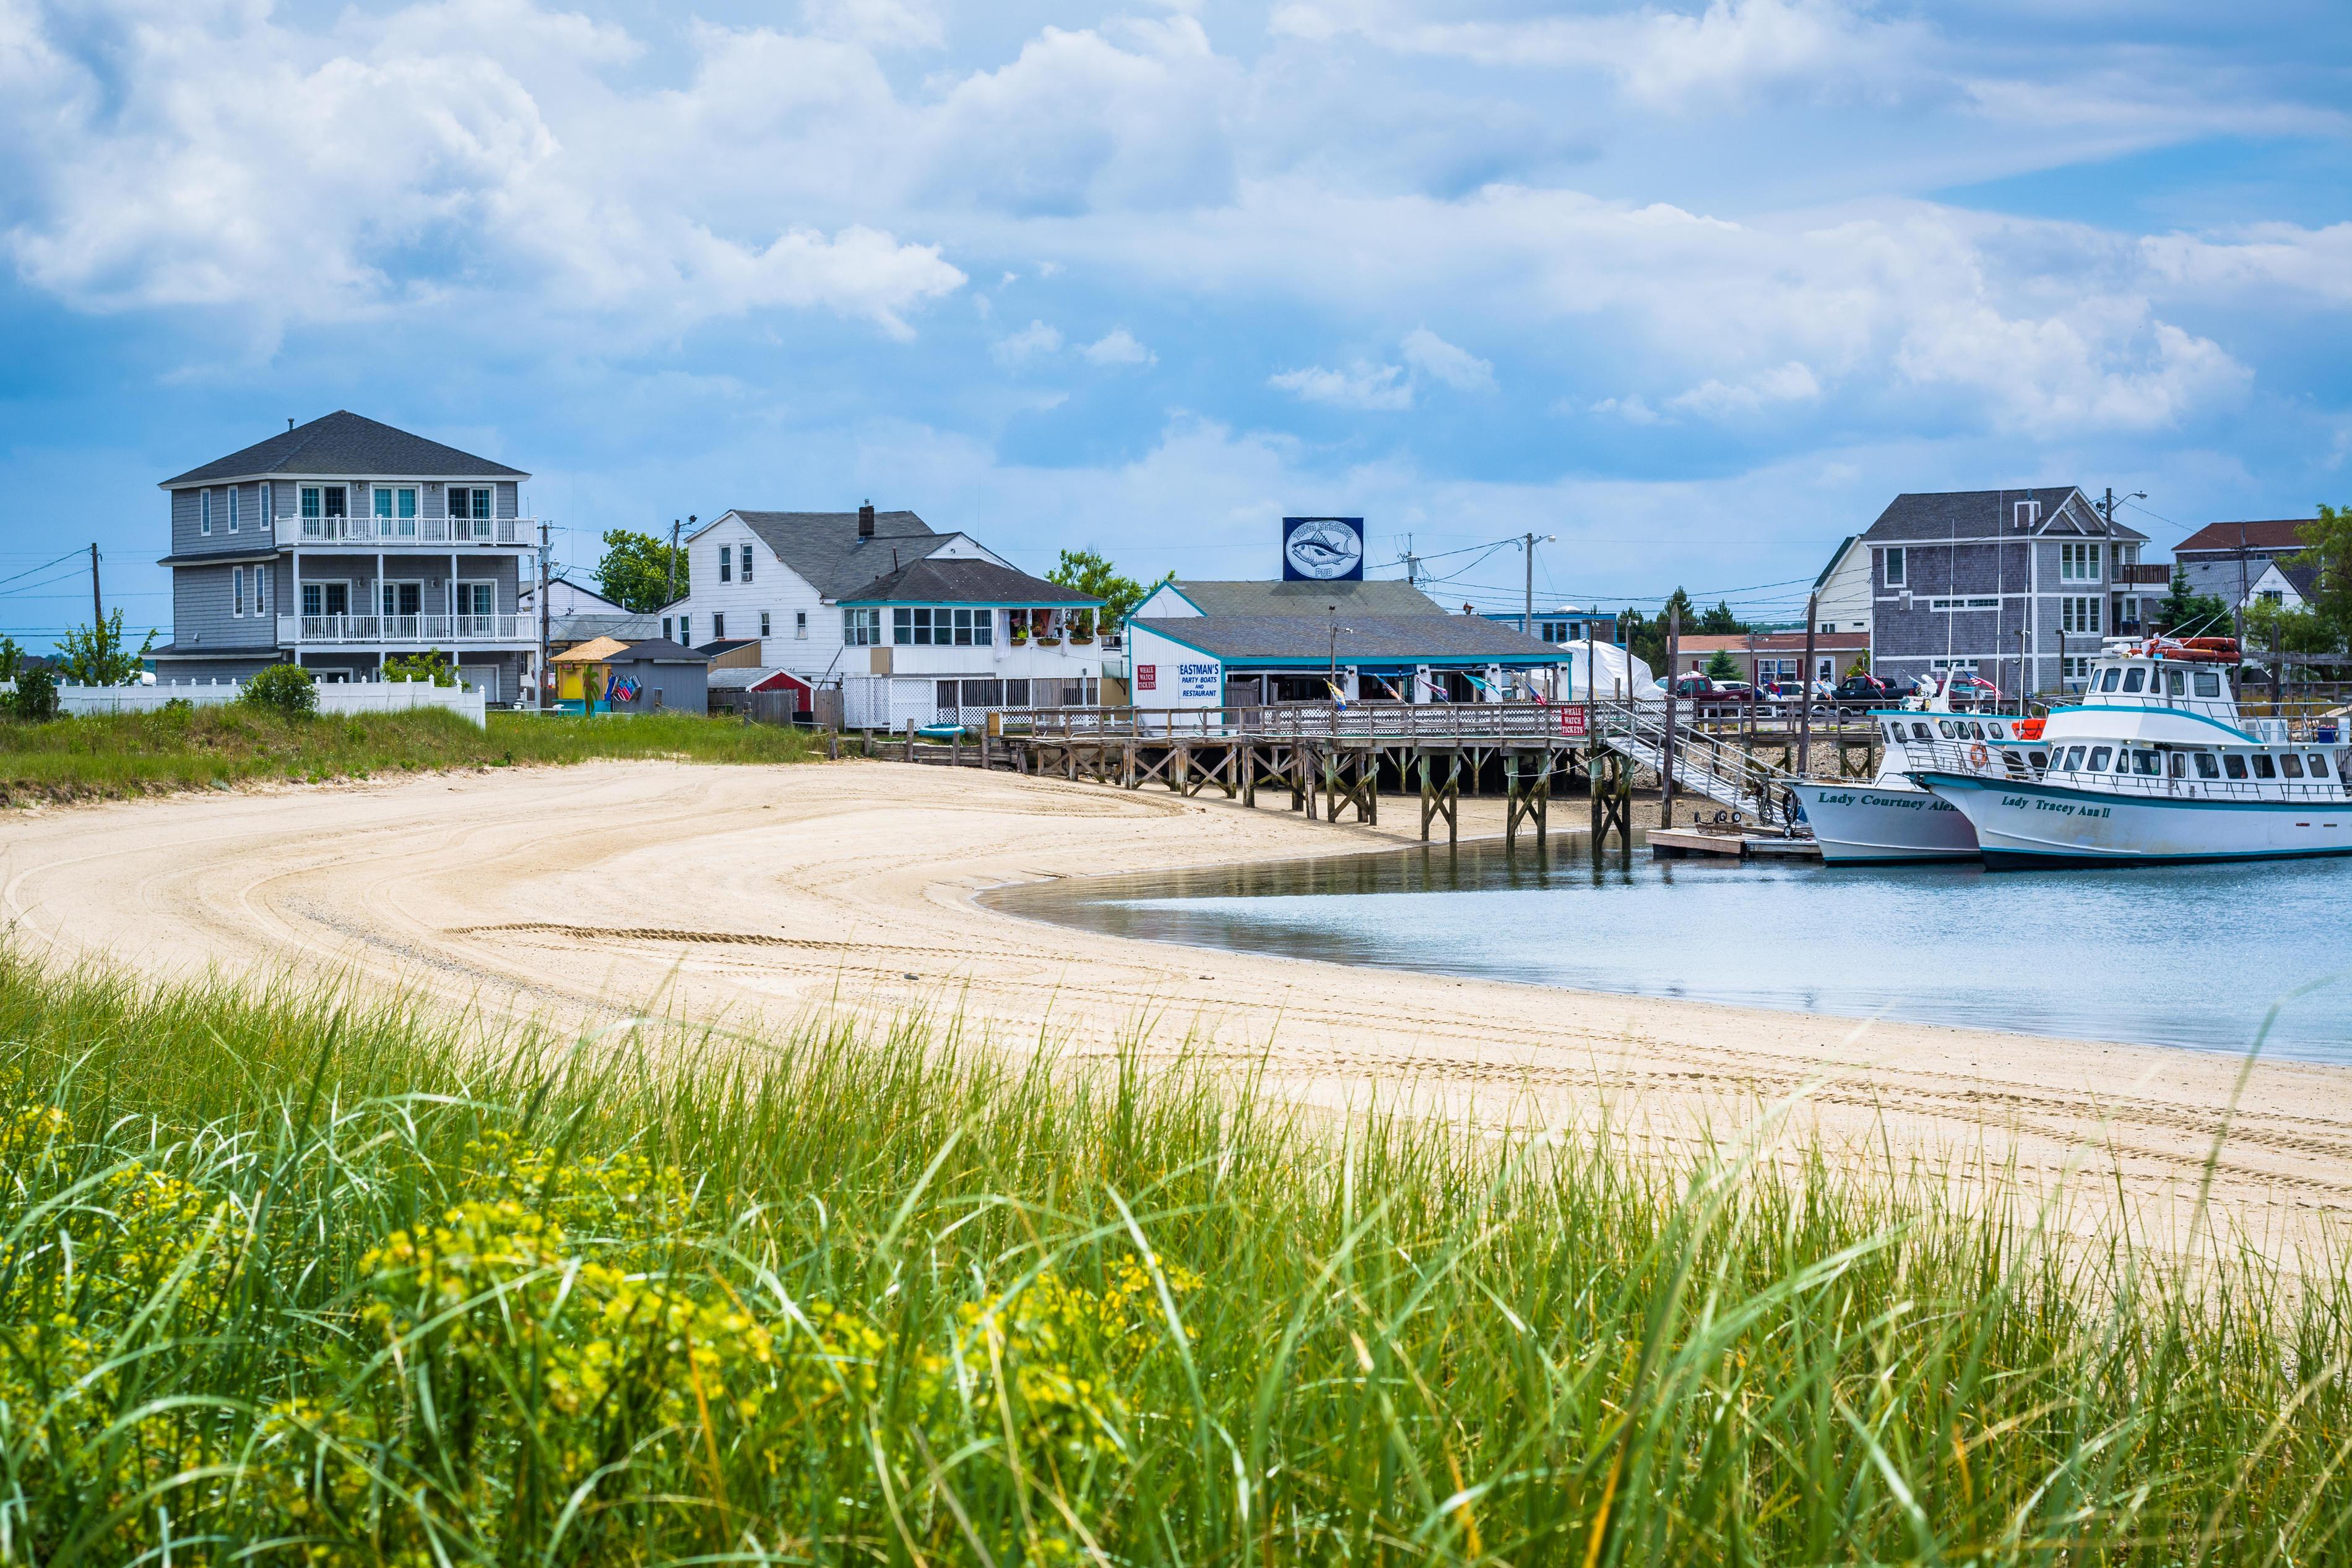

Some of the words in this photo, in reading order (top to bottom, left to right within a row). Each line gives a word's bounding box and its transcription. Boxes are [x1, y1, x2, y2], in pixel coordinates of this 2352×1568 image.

[1293, 522, 1317, 540] TUNA
[1318, 522, 1354, 540] STRIKER
[1315, 567, 1333, 577] PUB
[1180, 663, 1219, 675] EASTMAN'S
[1564, 717, 1581, 725] WATCH
[1562, 726, 1583, 734] TICKETS
[1818, 792, 1856, 806] Lady
[1861, 795, 1926, 811] Courtney
[2001, 796, 2030, 809] Lady
[2036, 799, 2076, 816] Tracey
[2077, 806, 2101, 817] Ann
